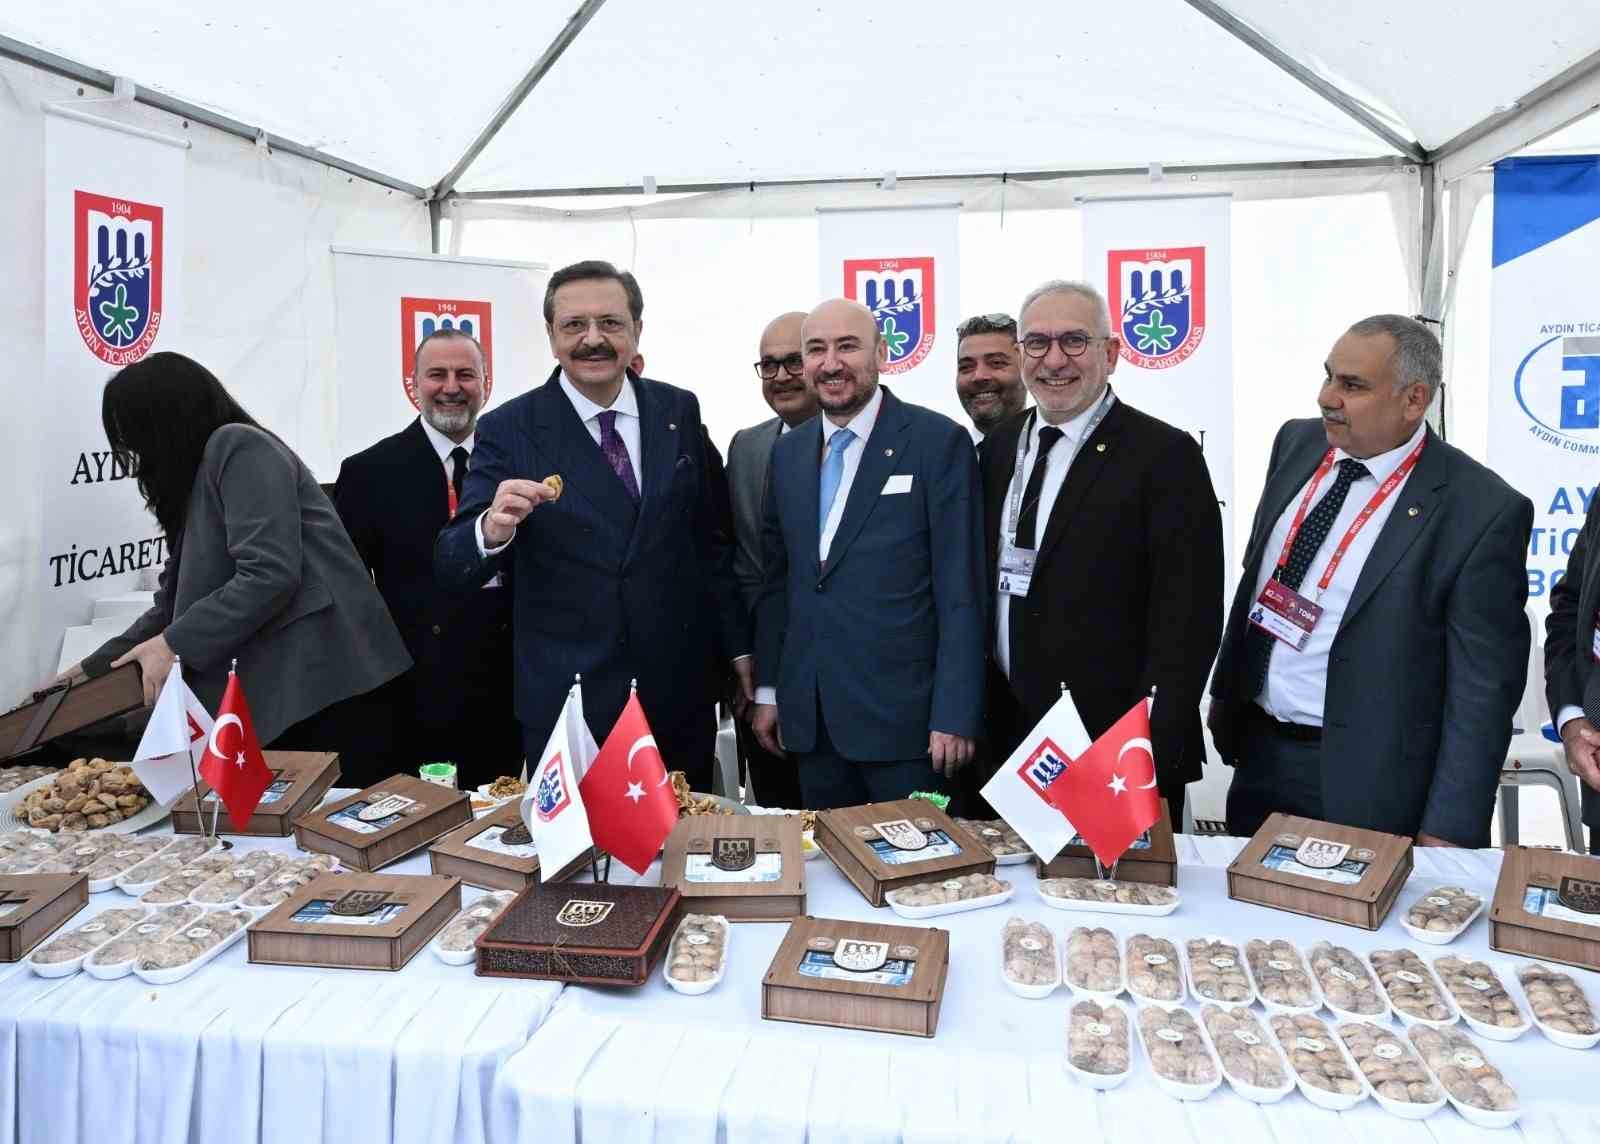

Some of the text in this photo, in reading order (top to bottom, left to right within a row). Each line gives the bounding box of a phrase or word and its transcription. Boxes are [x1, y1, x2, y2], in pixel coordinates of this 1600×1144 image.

[111, 201, 132, 216] 1904
[437, 303, 457, 313] 1904
[76, 308, 160, 366] AYDIN TİCARET ODASI
[1539, 323, 1575, 335] AYDIN
[1529, 425, 1562, 447] AYDIN
[49, 536, 167, 588] TİCARET
